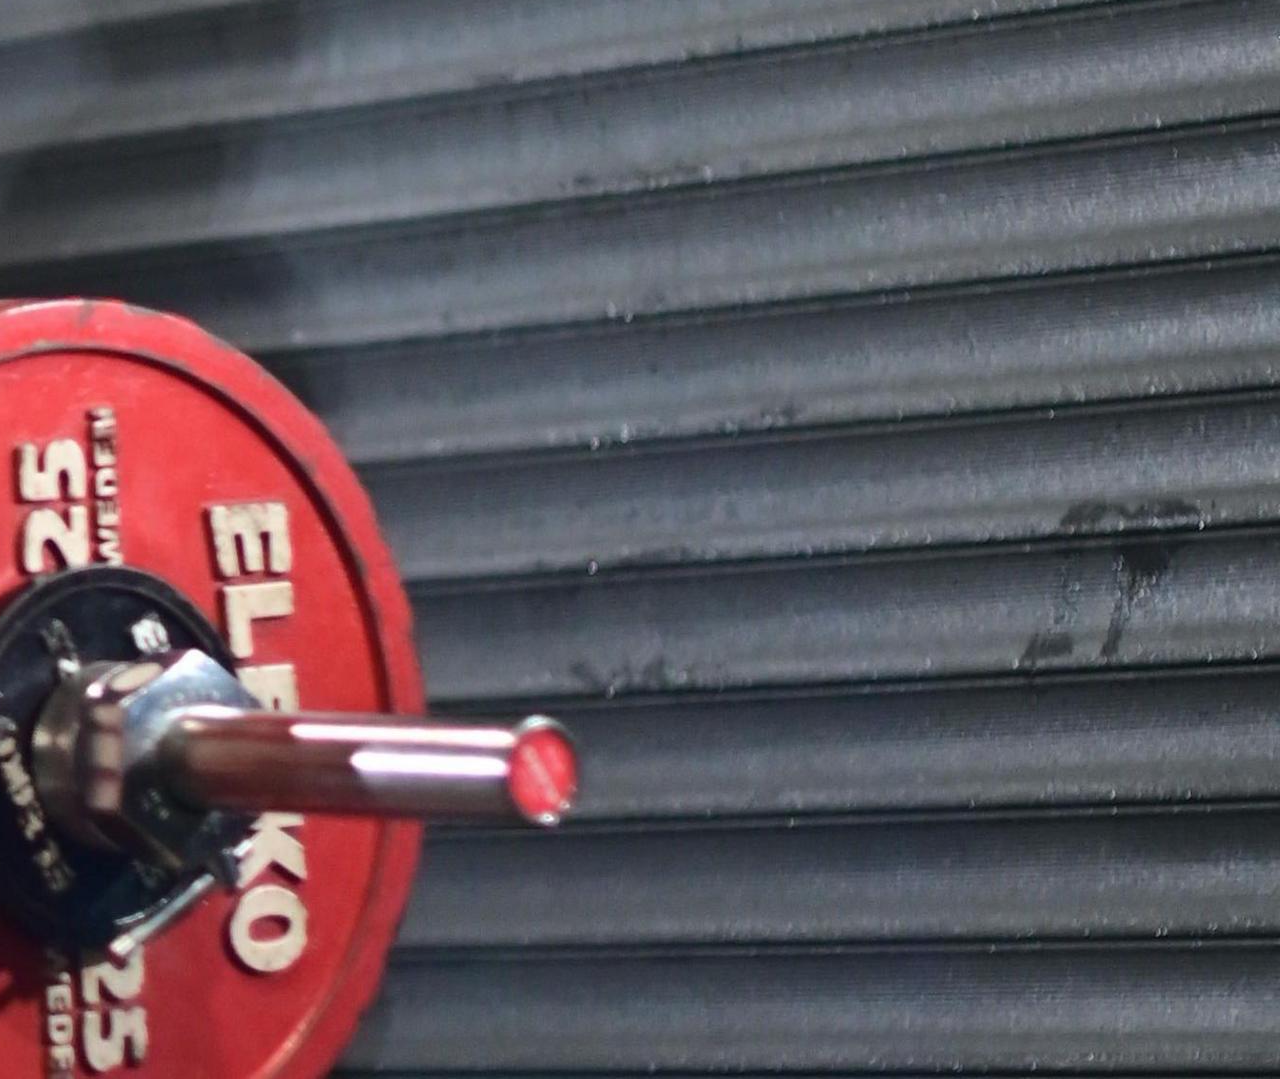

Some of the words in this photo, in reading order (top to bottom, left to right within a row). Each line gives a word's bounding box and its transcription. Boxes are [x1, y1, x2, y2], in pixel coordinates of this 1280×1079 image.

[20, 438, 89, 573] 25
[92, 407, 124, 565] WEDEN
[210, 501, 308, 973] ELEKO
[82, 944, 148, 1072] 25
